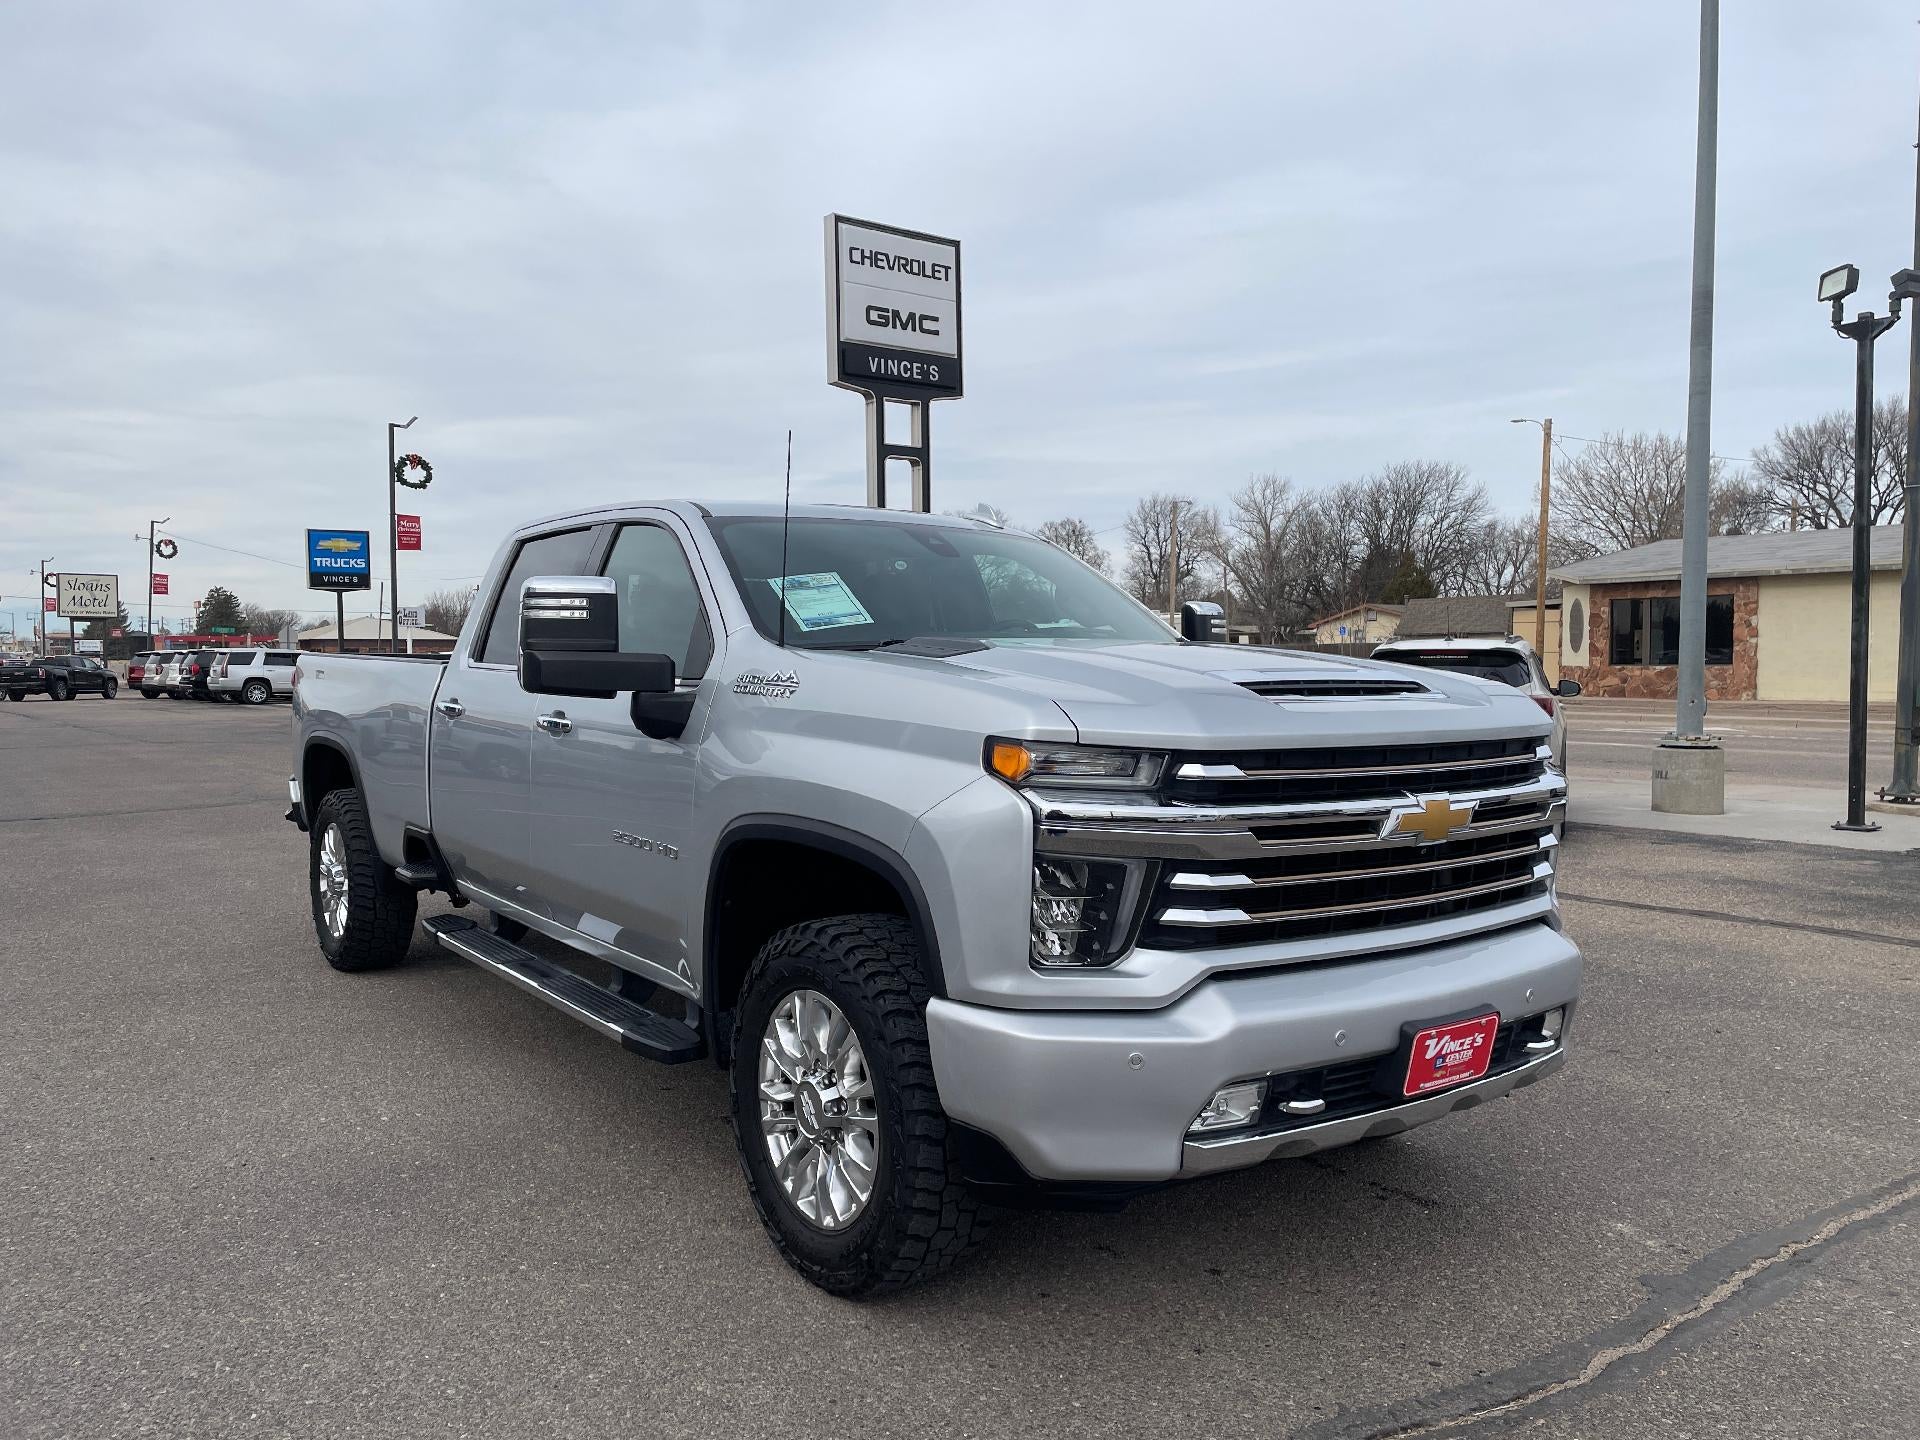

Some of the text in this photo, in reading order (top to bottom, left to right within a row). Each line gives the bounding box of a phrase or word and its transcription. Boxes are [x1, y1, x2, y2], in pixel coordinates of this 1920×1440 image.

[849, 246, 951, 282] CHEVROLET
[865, 304, 940, 336] GMC
[868, 356, 939, 381] VINCE'S
[313, 557, 366, 568] TRUCKS
[65, 577, 111, 592] Sloans
[322, 575, 359, 583] VINCE'S
[67, 594, 109, 608] Motel
